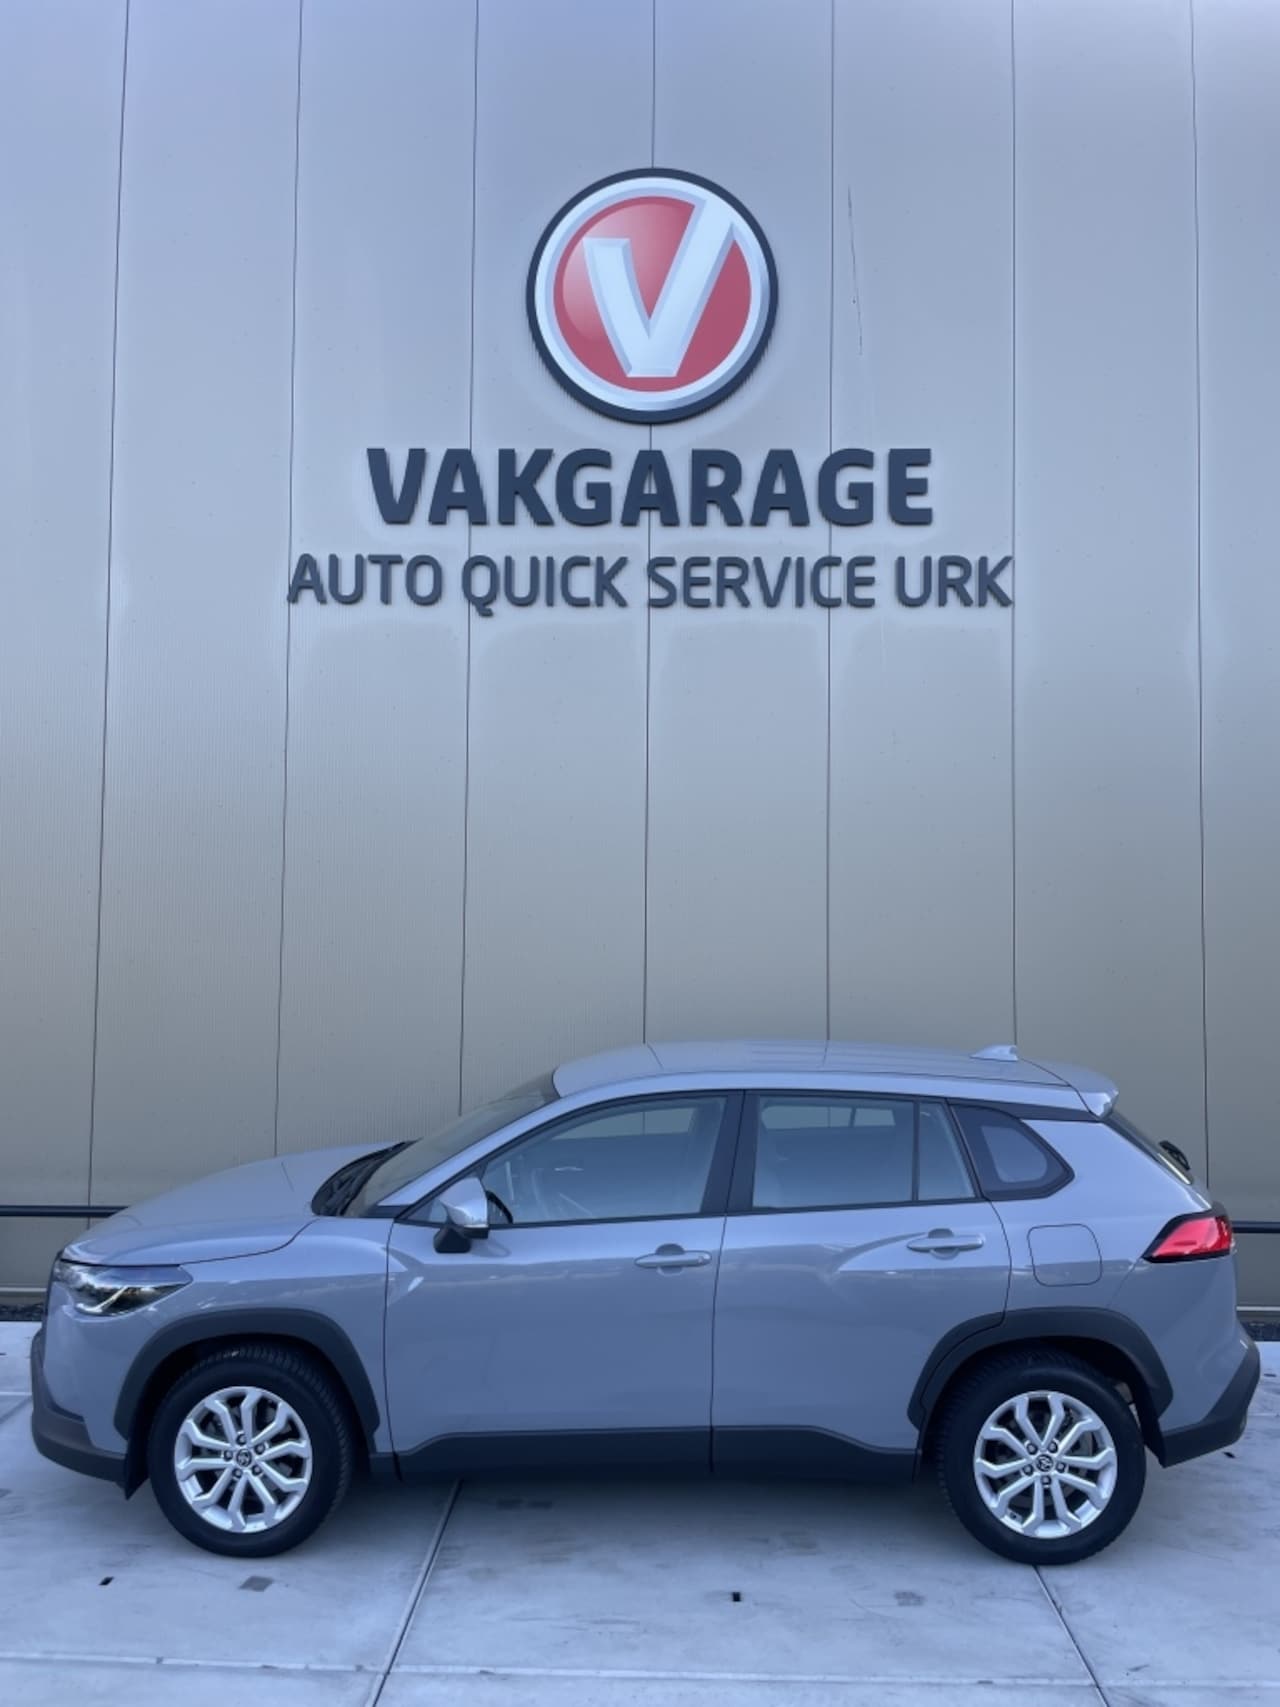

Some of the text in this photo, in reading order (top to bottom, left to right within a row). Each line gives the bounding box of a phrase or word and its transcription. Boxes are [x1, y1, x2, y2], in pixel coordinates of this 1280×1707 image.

[583, 196, 734, 377] V
[367, 448, 933, 527] VAKGARAGE
[288, 554, 1014, 617] AUTO QUICK SERVICE URK
